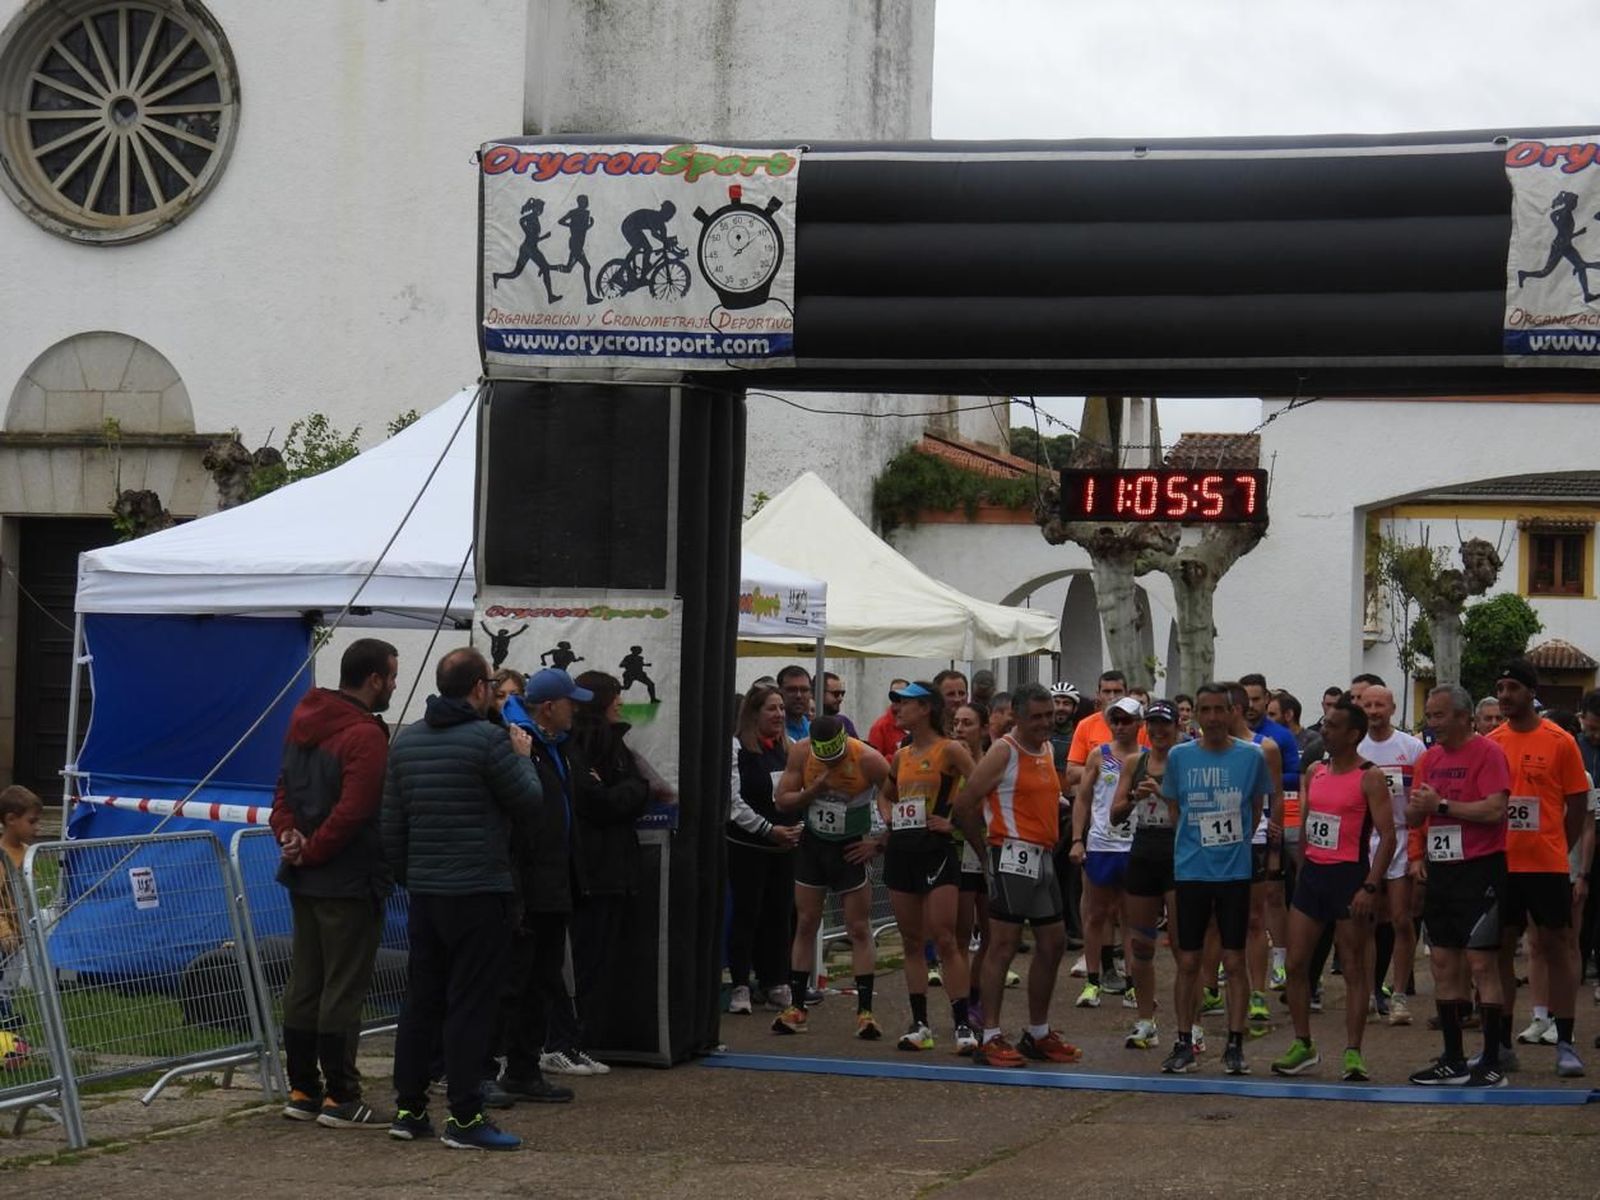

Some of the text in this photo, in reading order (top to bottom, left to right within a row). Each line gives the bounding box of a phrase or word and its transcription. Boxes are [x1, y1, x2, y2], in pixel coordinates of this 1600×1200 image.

[602, 309, 710, 328] CRONOMETRAJE
[718, 312, 792, 329] DEPORTIVO
[501, 334, 770, 356] www.orycronsport.com
[637, 814, 668, 822] om
[816, 809, 835, 824] 13
[898, 804, 916, 818] 16
[1508, 805, 1529, 820] 26
[1212, 819, 1232, 834] 11
[1311, 821, 1329, 837] 18
[1433, 835, 1451, 850] 21
[1018, 850, 1028, 864] 9
